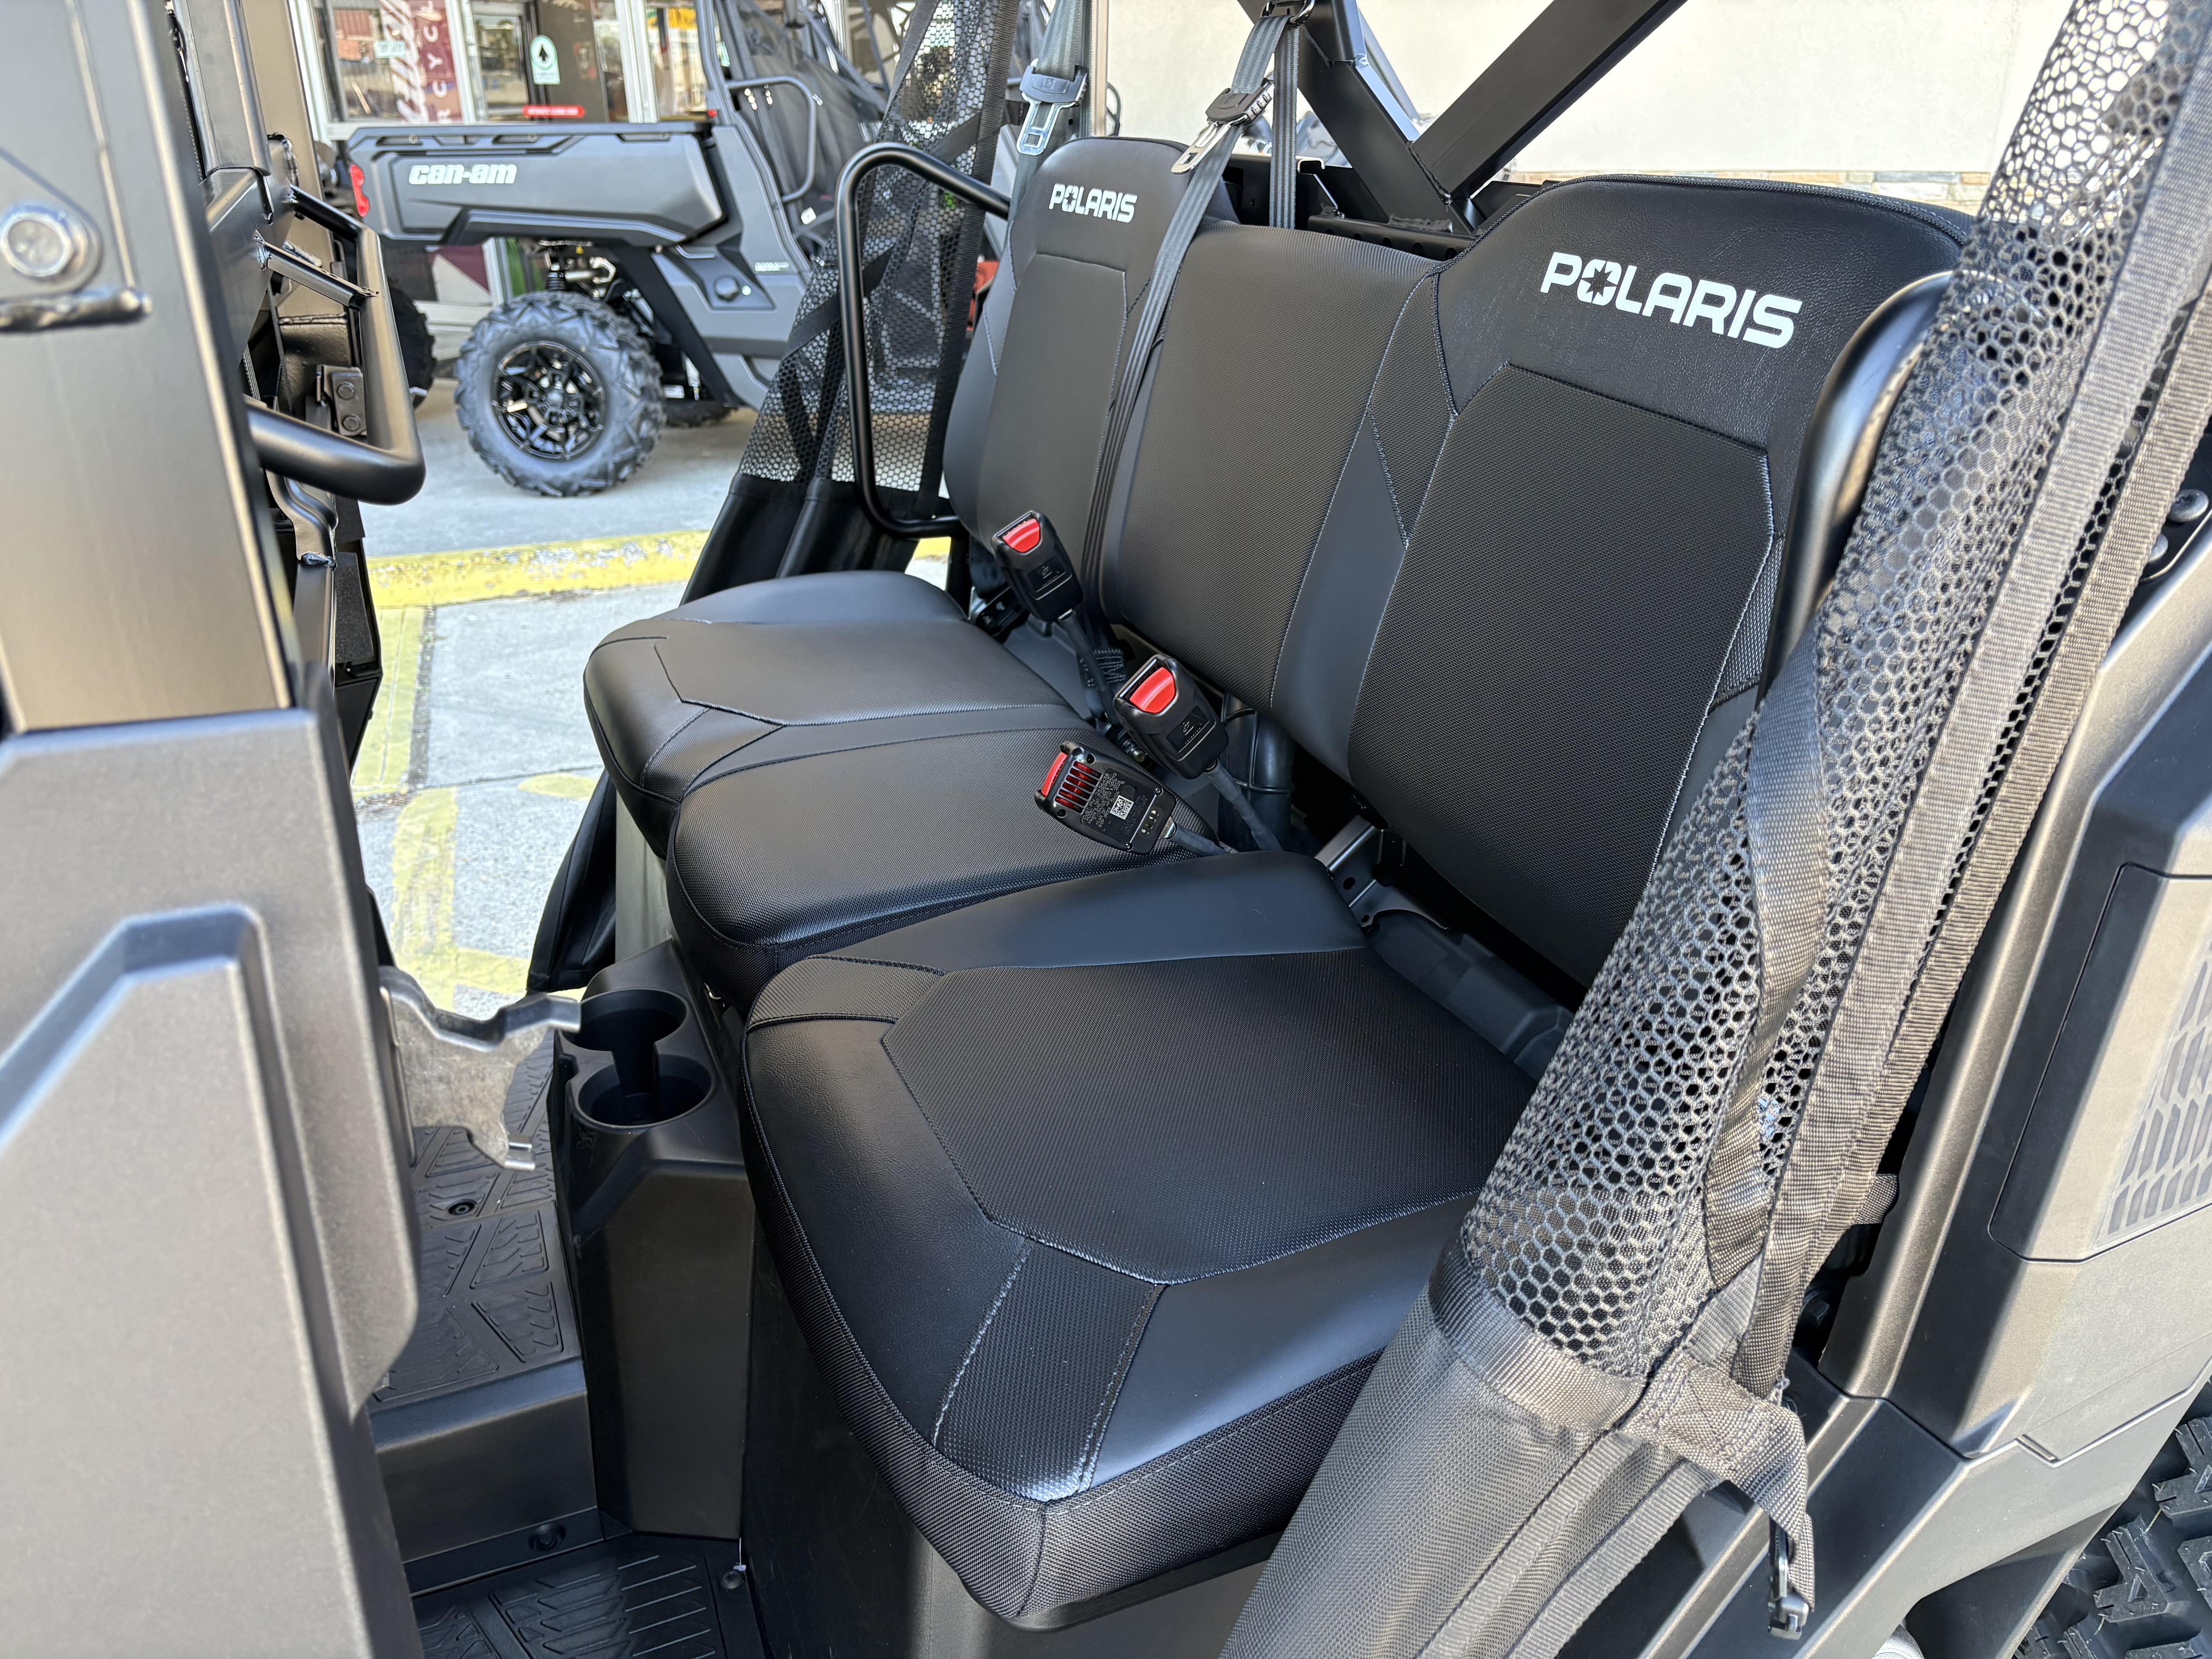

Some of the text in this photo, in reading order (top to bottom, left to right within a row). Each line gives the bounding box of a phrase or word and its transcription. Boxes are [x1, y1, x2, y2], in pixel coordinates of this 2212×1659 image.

[421, 0, 453, 123] RCYCL
[1049, 183, 1138, 223] POLARIS
[1540, 252, 1803, 349] POLARIS
